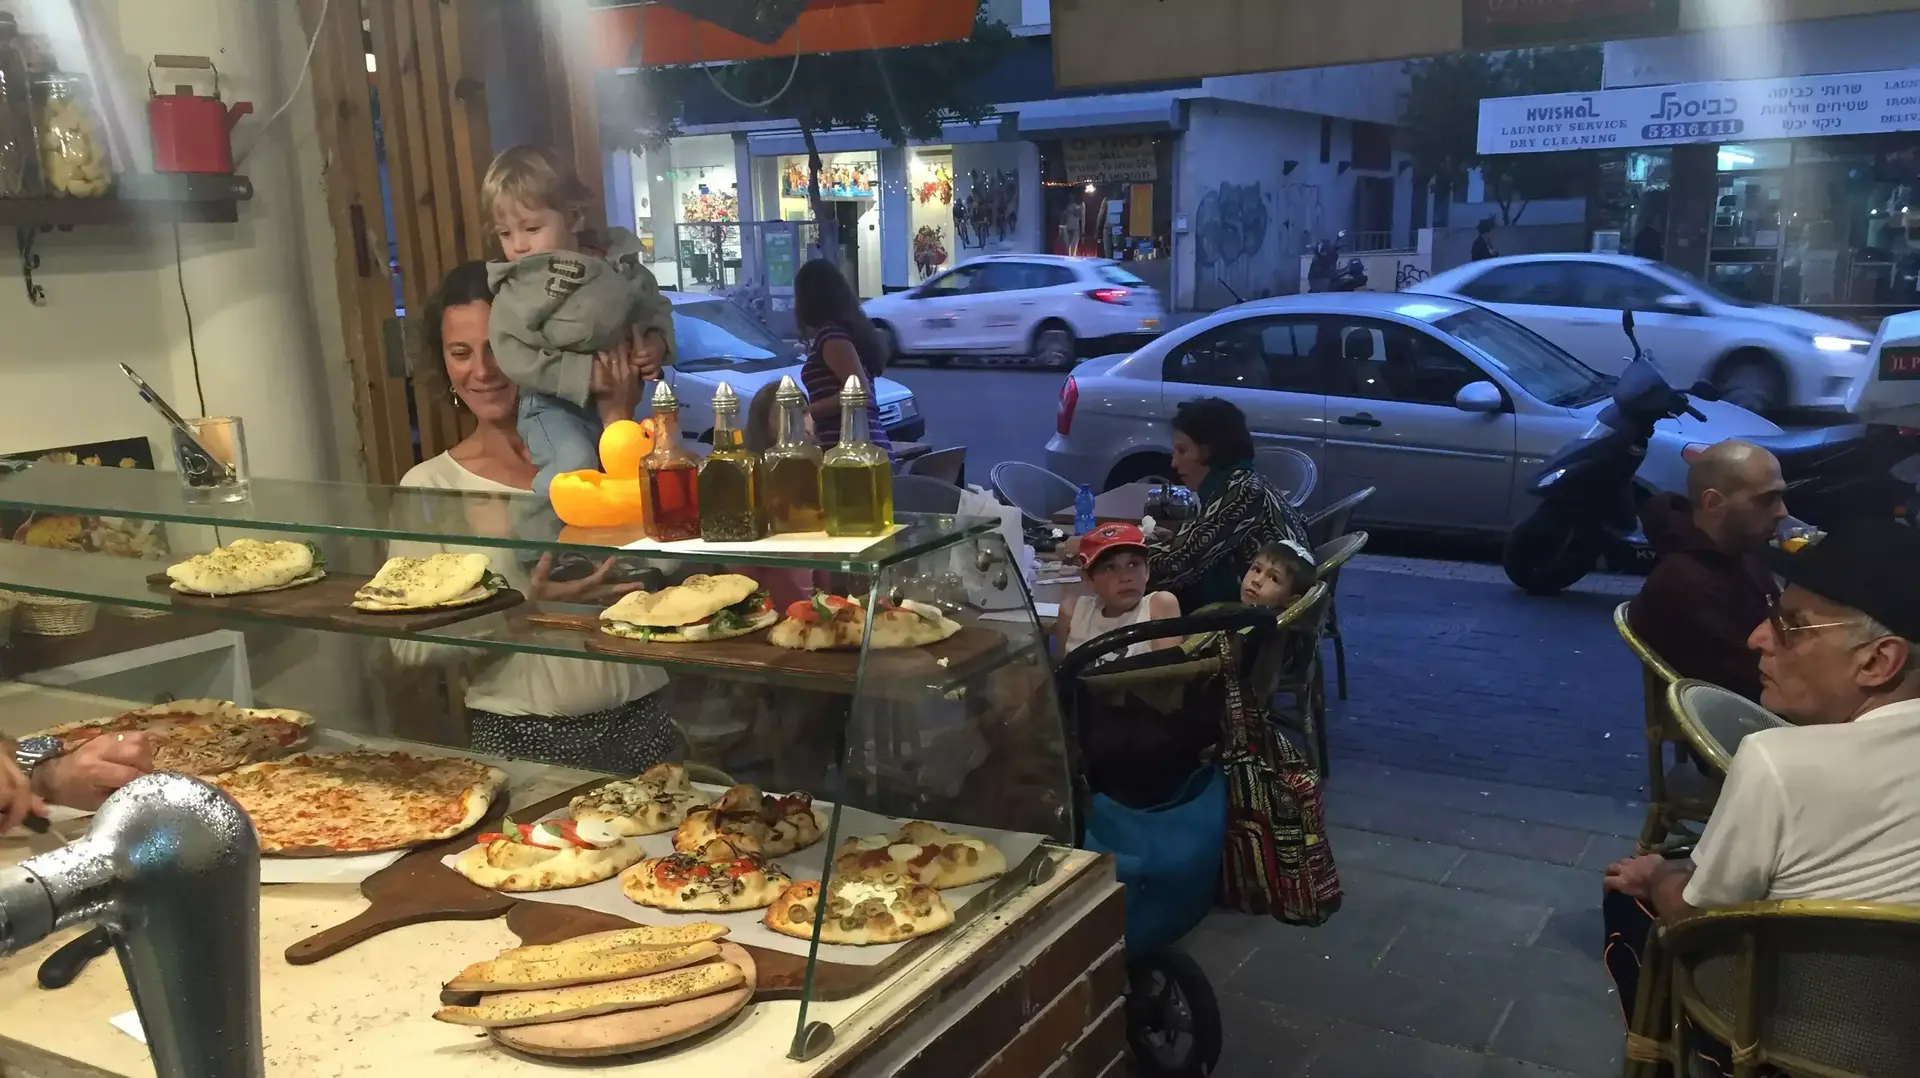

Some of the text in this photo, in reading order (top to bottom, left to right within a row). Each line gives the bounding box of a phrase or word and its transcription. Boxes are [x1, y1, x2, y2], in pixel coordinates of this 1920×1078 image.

[1820, 83, 1862, 96] שרותי
[1885, 80, 1920, 90] LAUN
[1815, 99, 1869, 113] שטיחים
[1501, 119, 1628, 136] LAUNDRY SERVICE
[1647, 120, 1737, 138] 5236411
[1509, 133, 1617, 148] DRY CLEANING
[1635, 550, 1657, 560] KY
